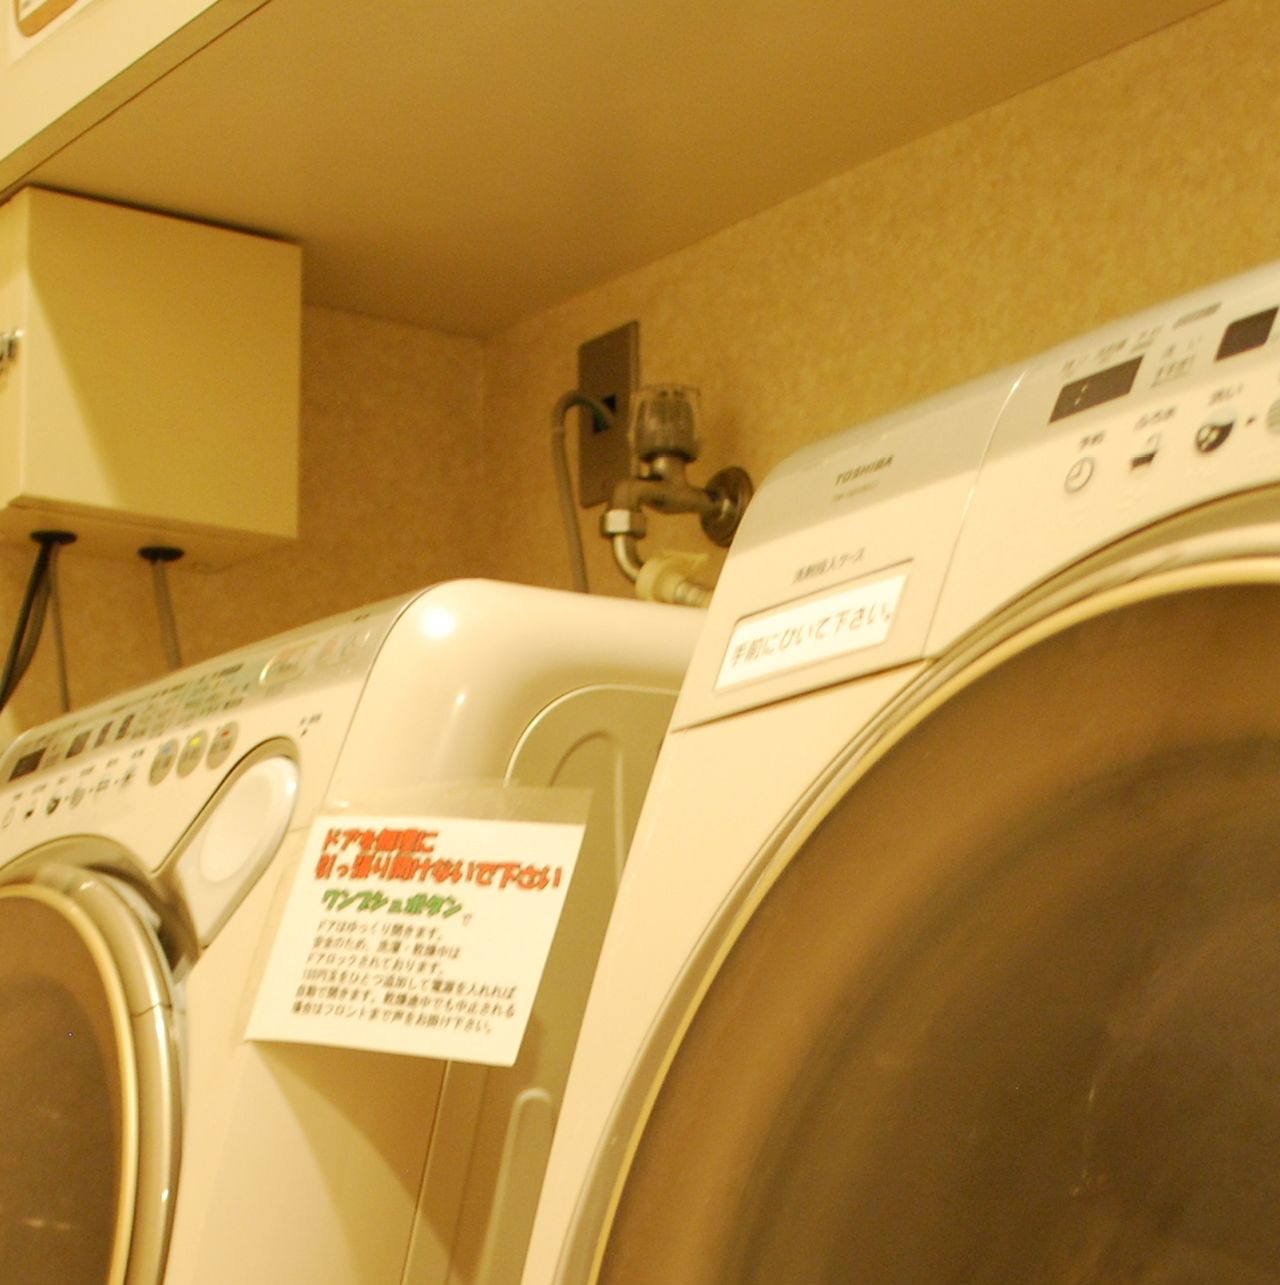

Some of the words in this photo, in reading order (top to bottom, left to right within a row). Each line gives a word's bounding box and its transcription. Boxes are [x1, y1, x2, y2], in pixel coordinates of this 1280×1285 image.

[834, 454, 896, 486] TOSHIBA
[732, 604, 891, 667] 手前にひいて下さい。
